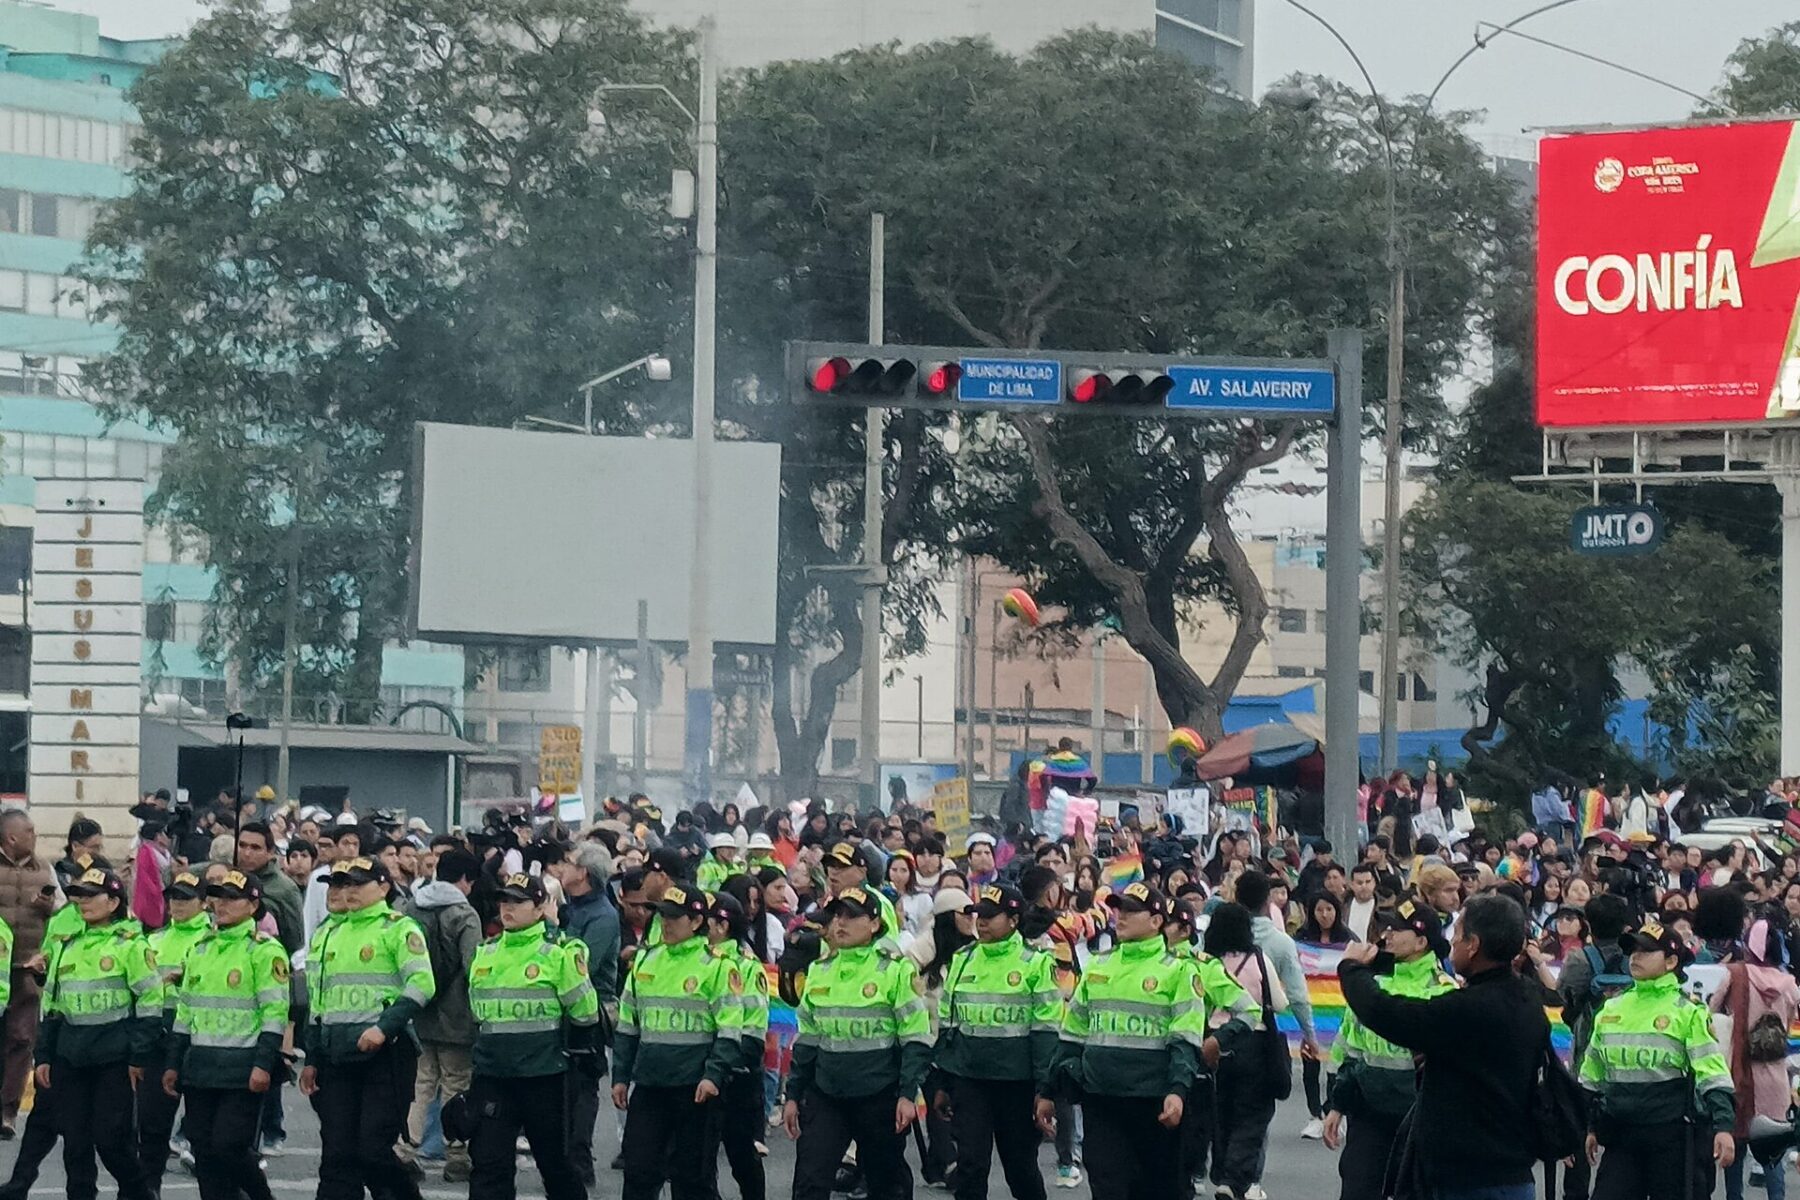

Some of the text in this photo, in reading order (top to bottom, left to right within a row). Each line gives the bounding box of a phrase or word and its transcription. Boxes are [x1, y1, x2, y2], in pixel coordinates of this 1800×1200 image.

[1554, 233, 1743, 315] CONFÍA
[966, 363, 1054, 380] MUNICIPALIDAD
[989, 382, 1034, 397] DE LIMA
[1189, 378, 1312, 399] AV. SALAVERRY
